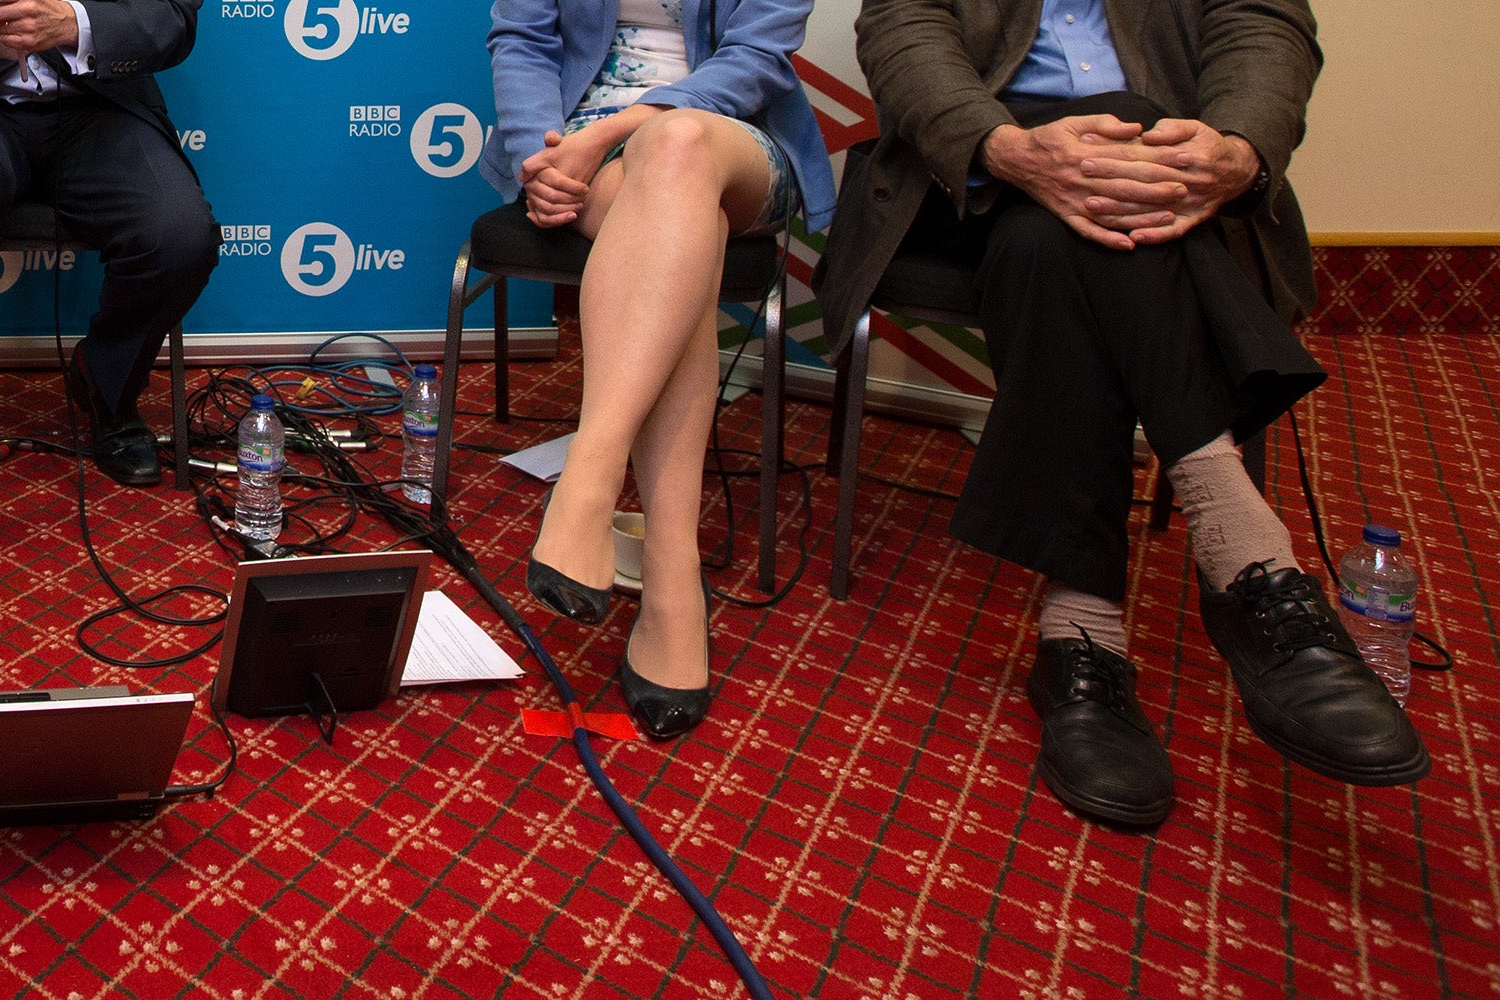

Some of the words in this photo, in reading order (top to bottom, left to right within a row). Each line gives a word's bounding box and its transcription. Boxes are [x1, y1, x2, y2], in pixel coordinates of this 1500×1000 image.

[221, 4, 275, 18] RADIO
[361, 8, 409, 33] live
[352, 107, 399, 120] BBC
[349, 123, 402, 137] RADIO
[176, 129, 206, 151] ve
[428, 115, 466, 169] 5
[224, 226, 270, 240] BBC
[219, 242, 272, 256] RADIO
[299, 234, 336, 287] 5
[356, 244, 404, 270] live
